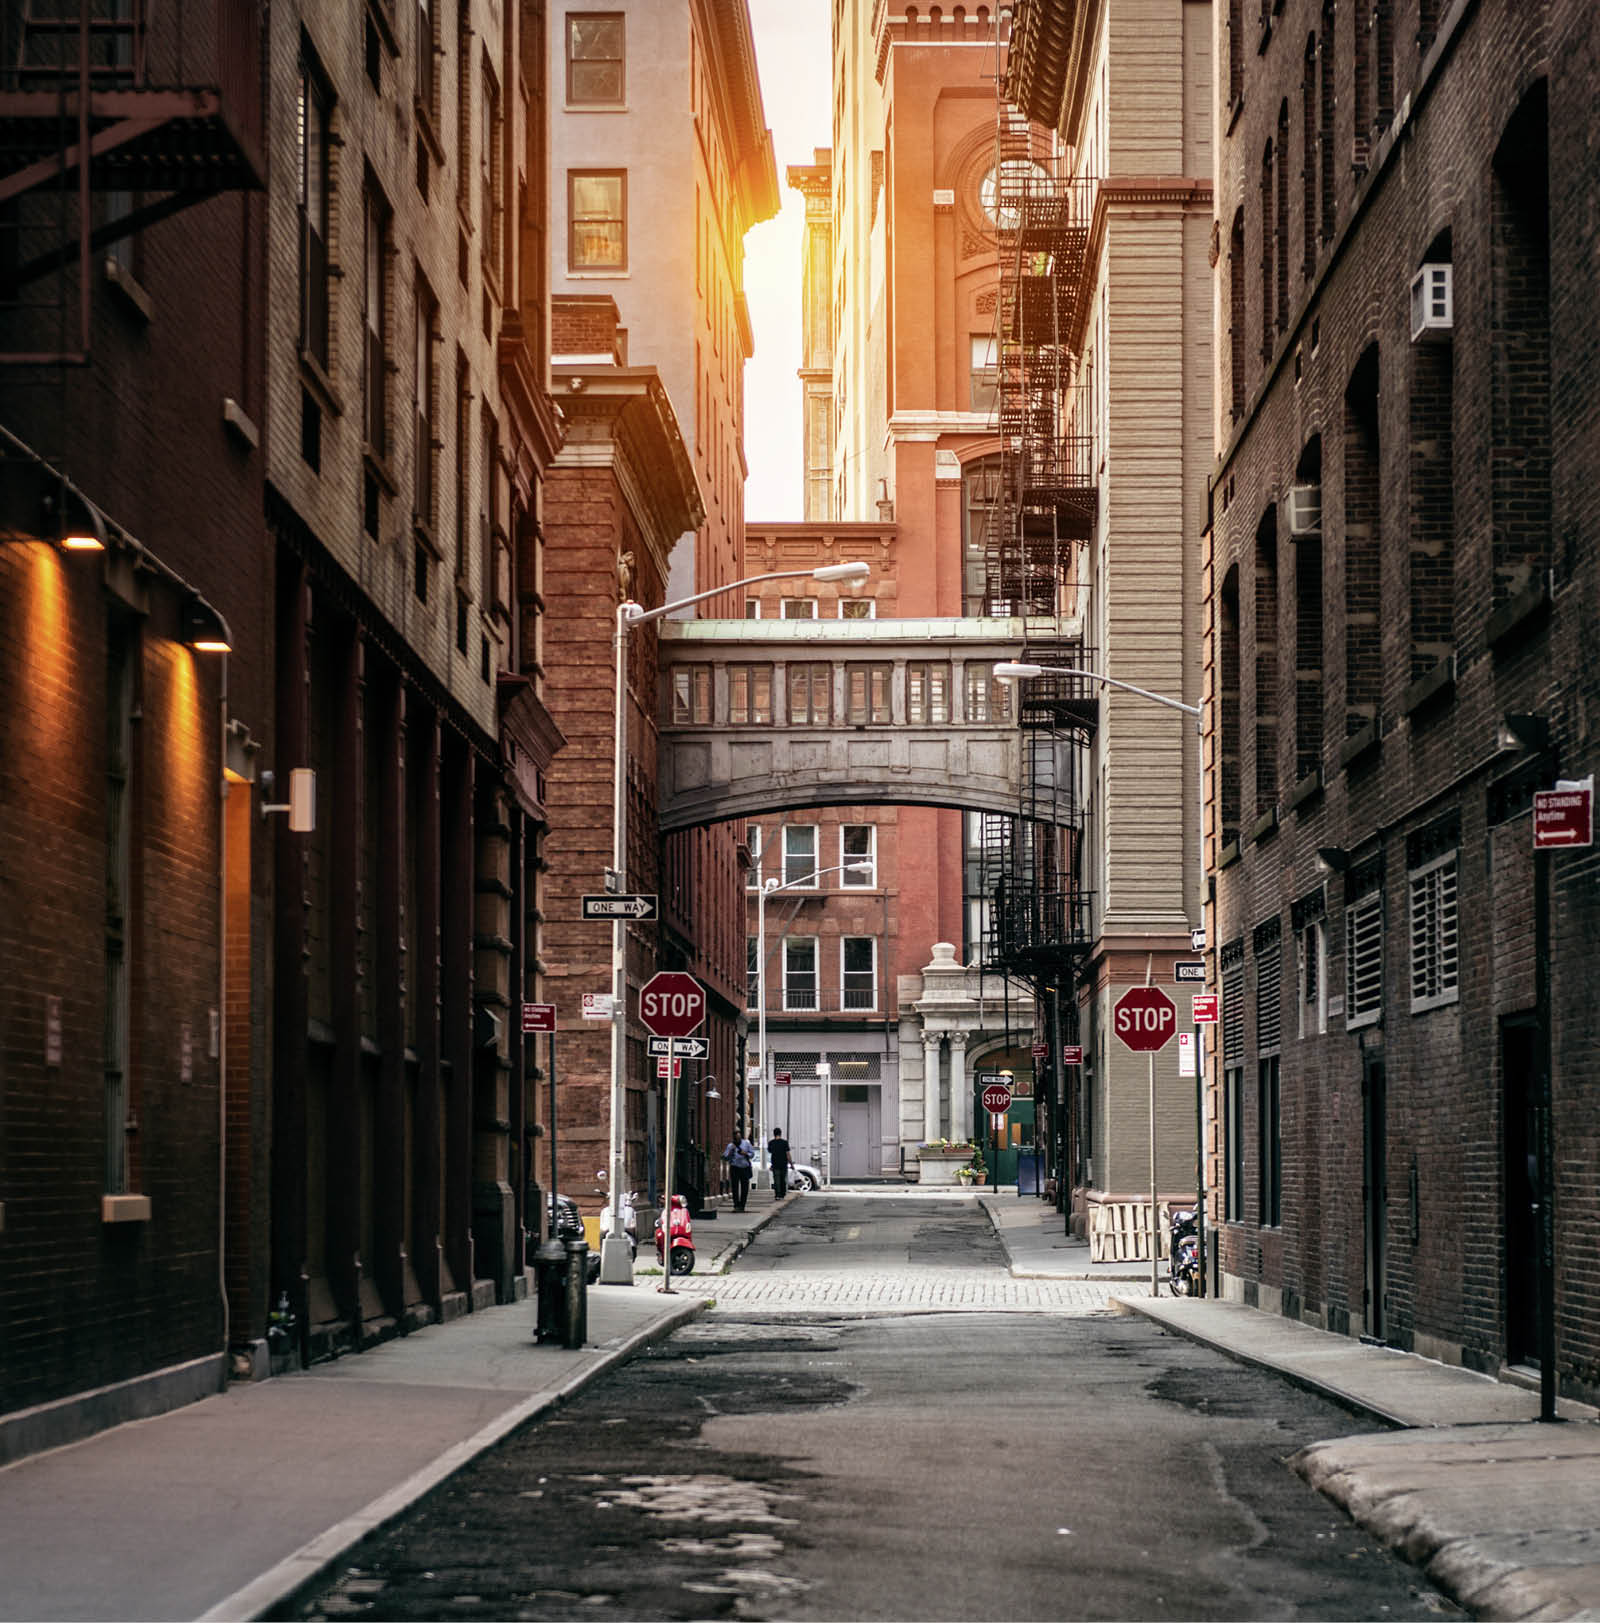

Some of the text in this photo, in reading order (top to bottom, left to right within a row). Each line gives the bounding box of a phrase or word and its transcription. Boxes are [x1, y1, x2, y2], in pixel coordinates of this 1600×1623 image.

[1537, 796, 1582, 809] NO STANDING
[1538, 811, 1566, 823] Anytime
[593, 903, 646, 912] ONE WAY
[1181, 968, 1199, 976] ONE
[644, 992, 701, 1017] STOP
[1118, 1007, 1173, 1032] STOP
[657, 1042, 700, 1052] ON WAY
[984, 1094, 1010, 1105] STOP
